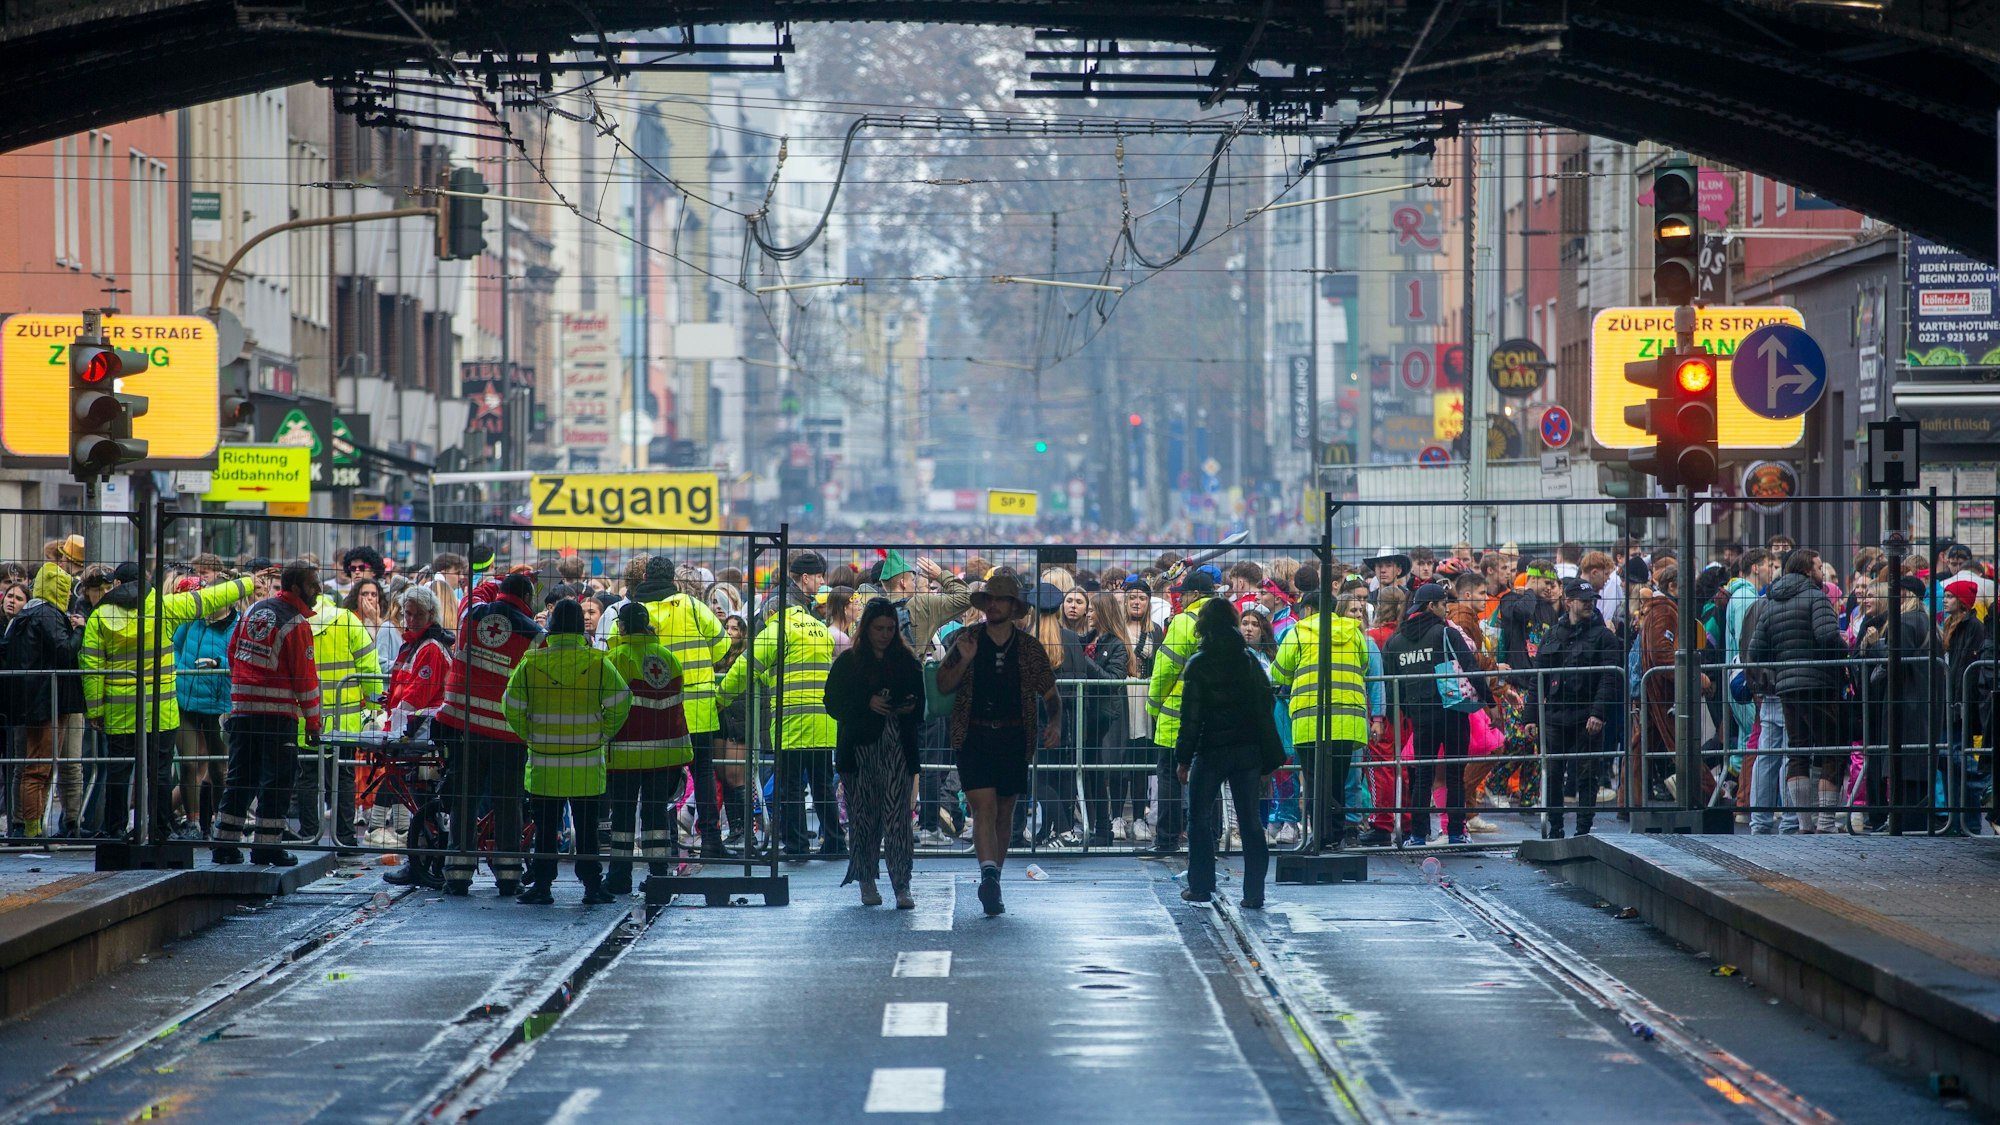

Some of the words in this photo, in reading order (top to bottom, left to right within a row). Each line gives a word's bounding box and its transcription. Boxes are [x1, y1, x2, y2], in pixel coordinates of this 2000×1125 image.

[1698, 180, 1724, 191] LUM
[1698, 193, 1723, 203] yros
[1919, 263, 1947, 272] JEDEN
[1949, 262, 1987, 272] FREITAG
[1919, 274, 1955, 283] BEGINN
[1957, 274, 1984, 283] 20.00
[16, 321, 124, 339] ZÜLPICER
[1608, 315, 1713, 331] ZÜLPICER
[1918, 333, 1939, 342] 0221
[1947, 333, 1963, 342] 923
[1965, 333, 1976, 341] 16
[1977, 332, 1989, 341] 54
[1638, 338, 1743, 358] ZUAN
[1499, 371, 1538, 388] BAR
[223, 452, 288, 467] Richtung
[1872, 429, 1916, 482] H
[211, 469, 299, 482] Südbahnhof
[538, 478, 713, 524] Zugang
[1001, 496, 1016, 507] SP
[808, 630, 824, 638] 410
[1399, 648, 1433, 666] SWAT
